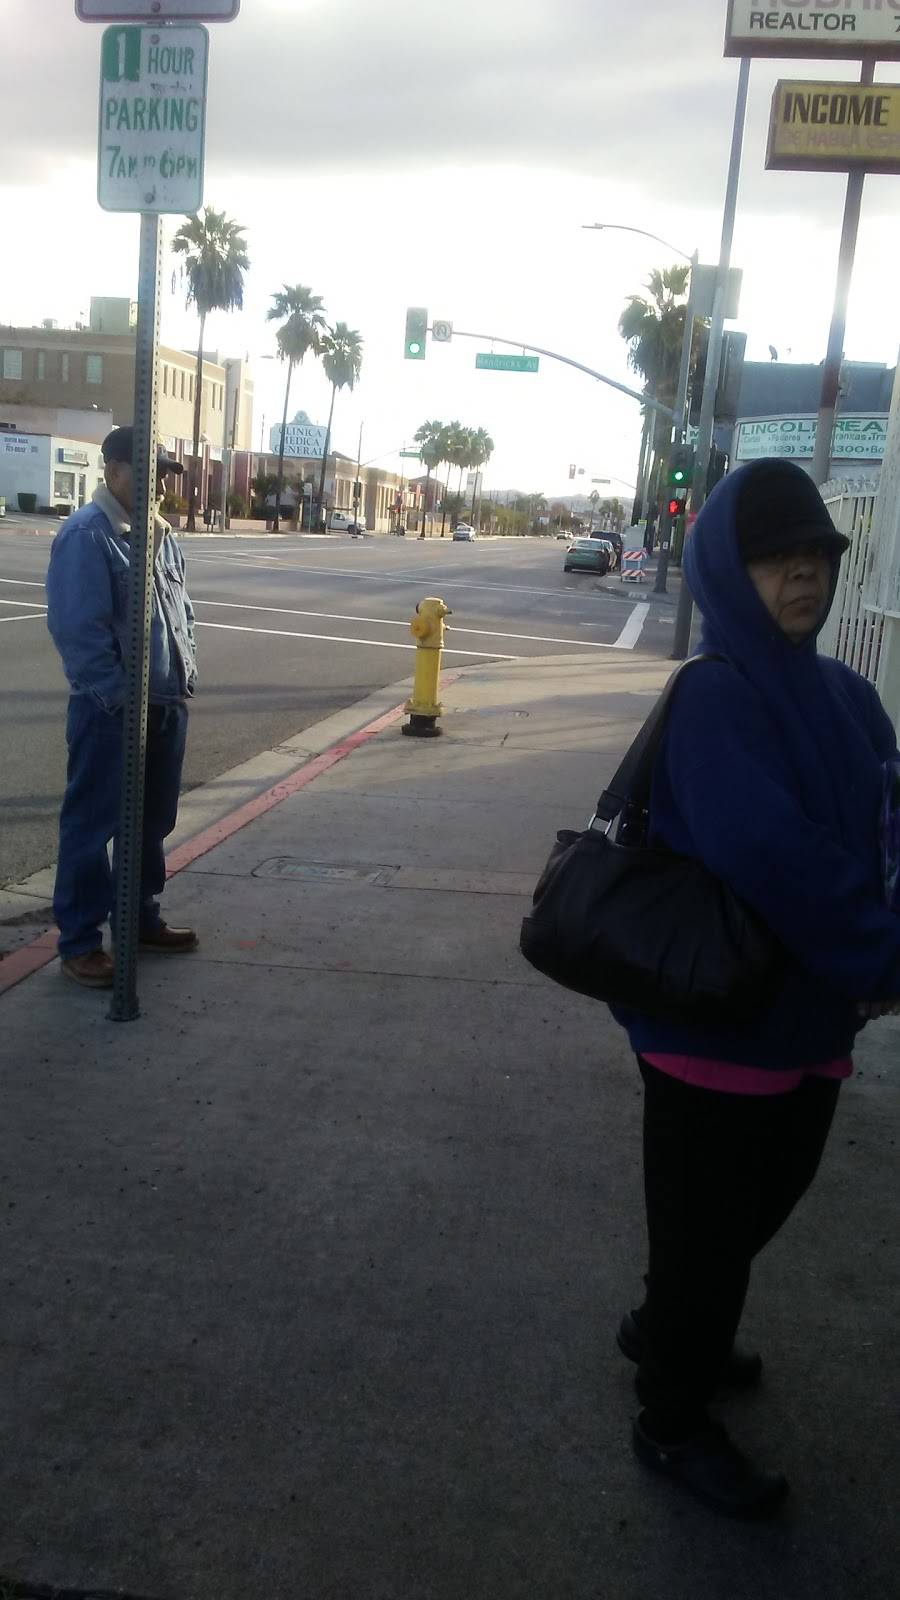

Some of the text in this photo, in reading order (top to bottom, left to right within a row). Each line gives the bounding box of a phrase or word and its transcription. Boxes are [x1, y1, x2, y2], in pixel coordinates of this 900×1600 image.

[749, 12, 857, 31] REALTOR
[117, 32, 195, 80] 1 HOUR
[105, 98, 198, 132] PARKING
[783, 92, 891, 126] INCOME
[106, 145, 137, 178] 7AM
[159, 150, 198, 179] 6PM
